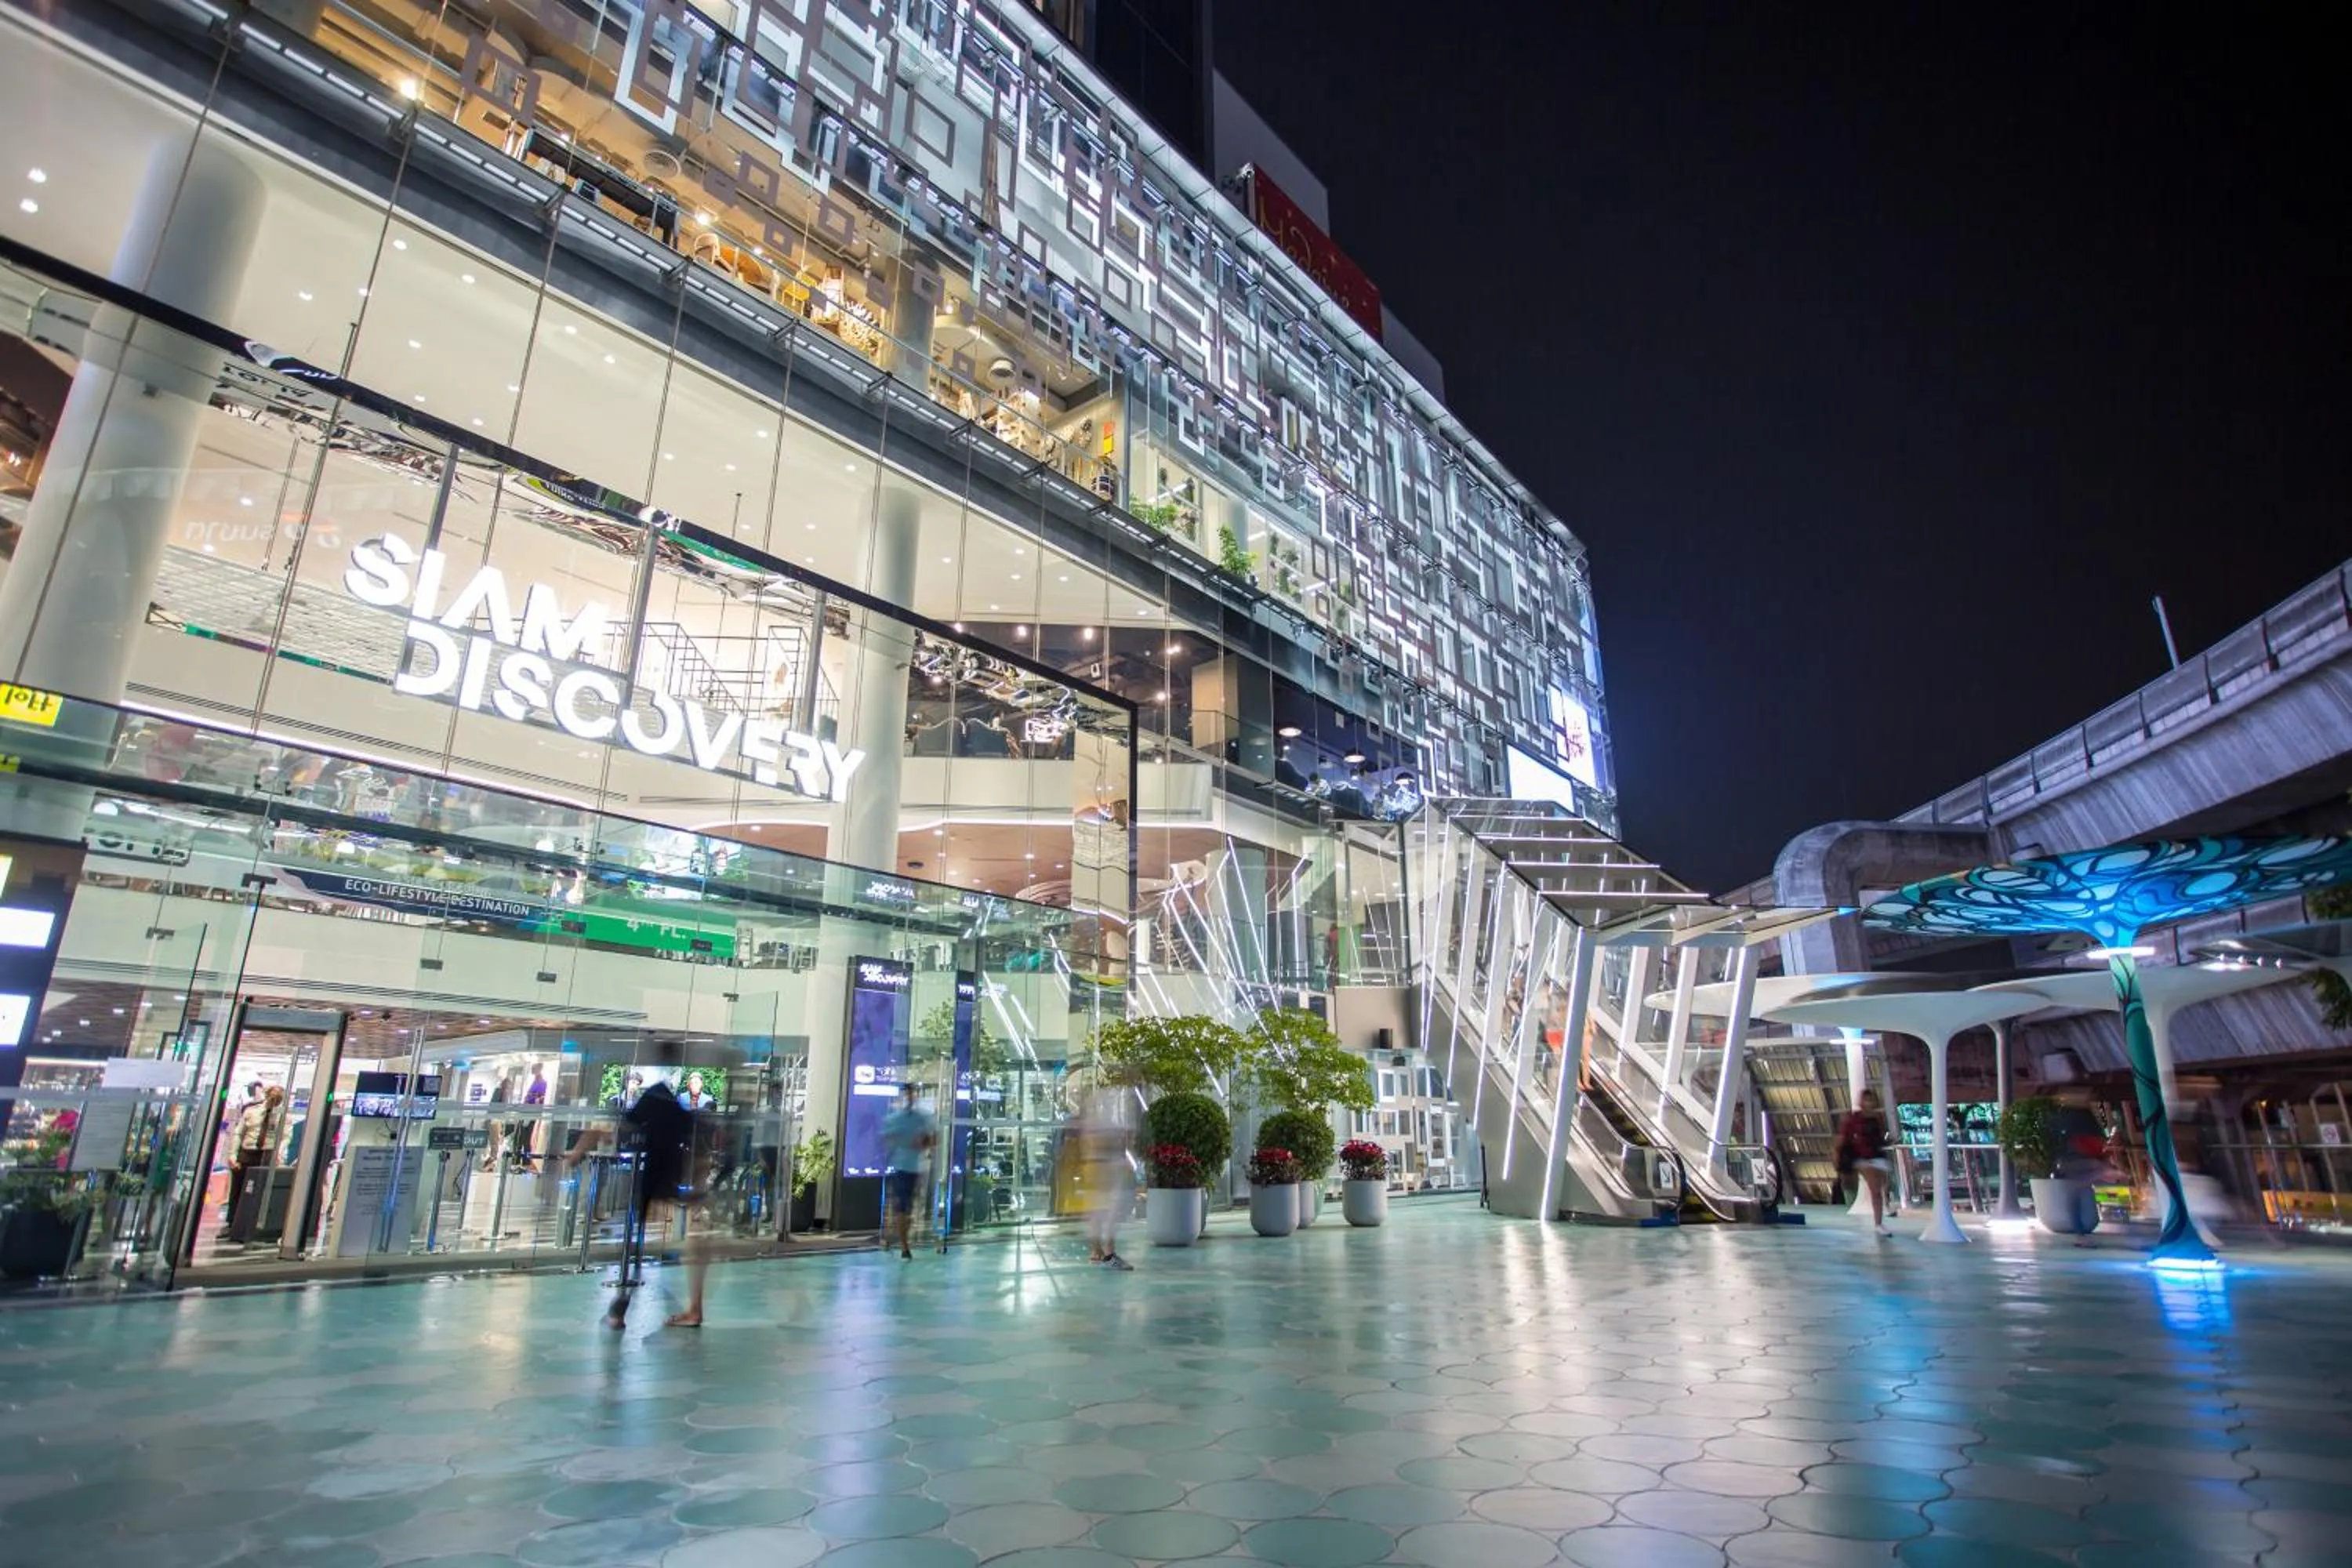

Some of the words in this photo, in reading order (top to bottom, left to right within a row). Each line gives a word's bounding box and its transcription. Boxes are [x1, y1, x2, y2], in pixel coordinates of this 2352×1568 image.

[344, 532, 608, 661] SIAM
[394, 620, 866, 802] DISCOVERY
[344, 879, 446, 904] ECO-LIFESTYLE
